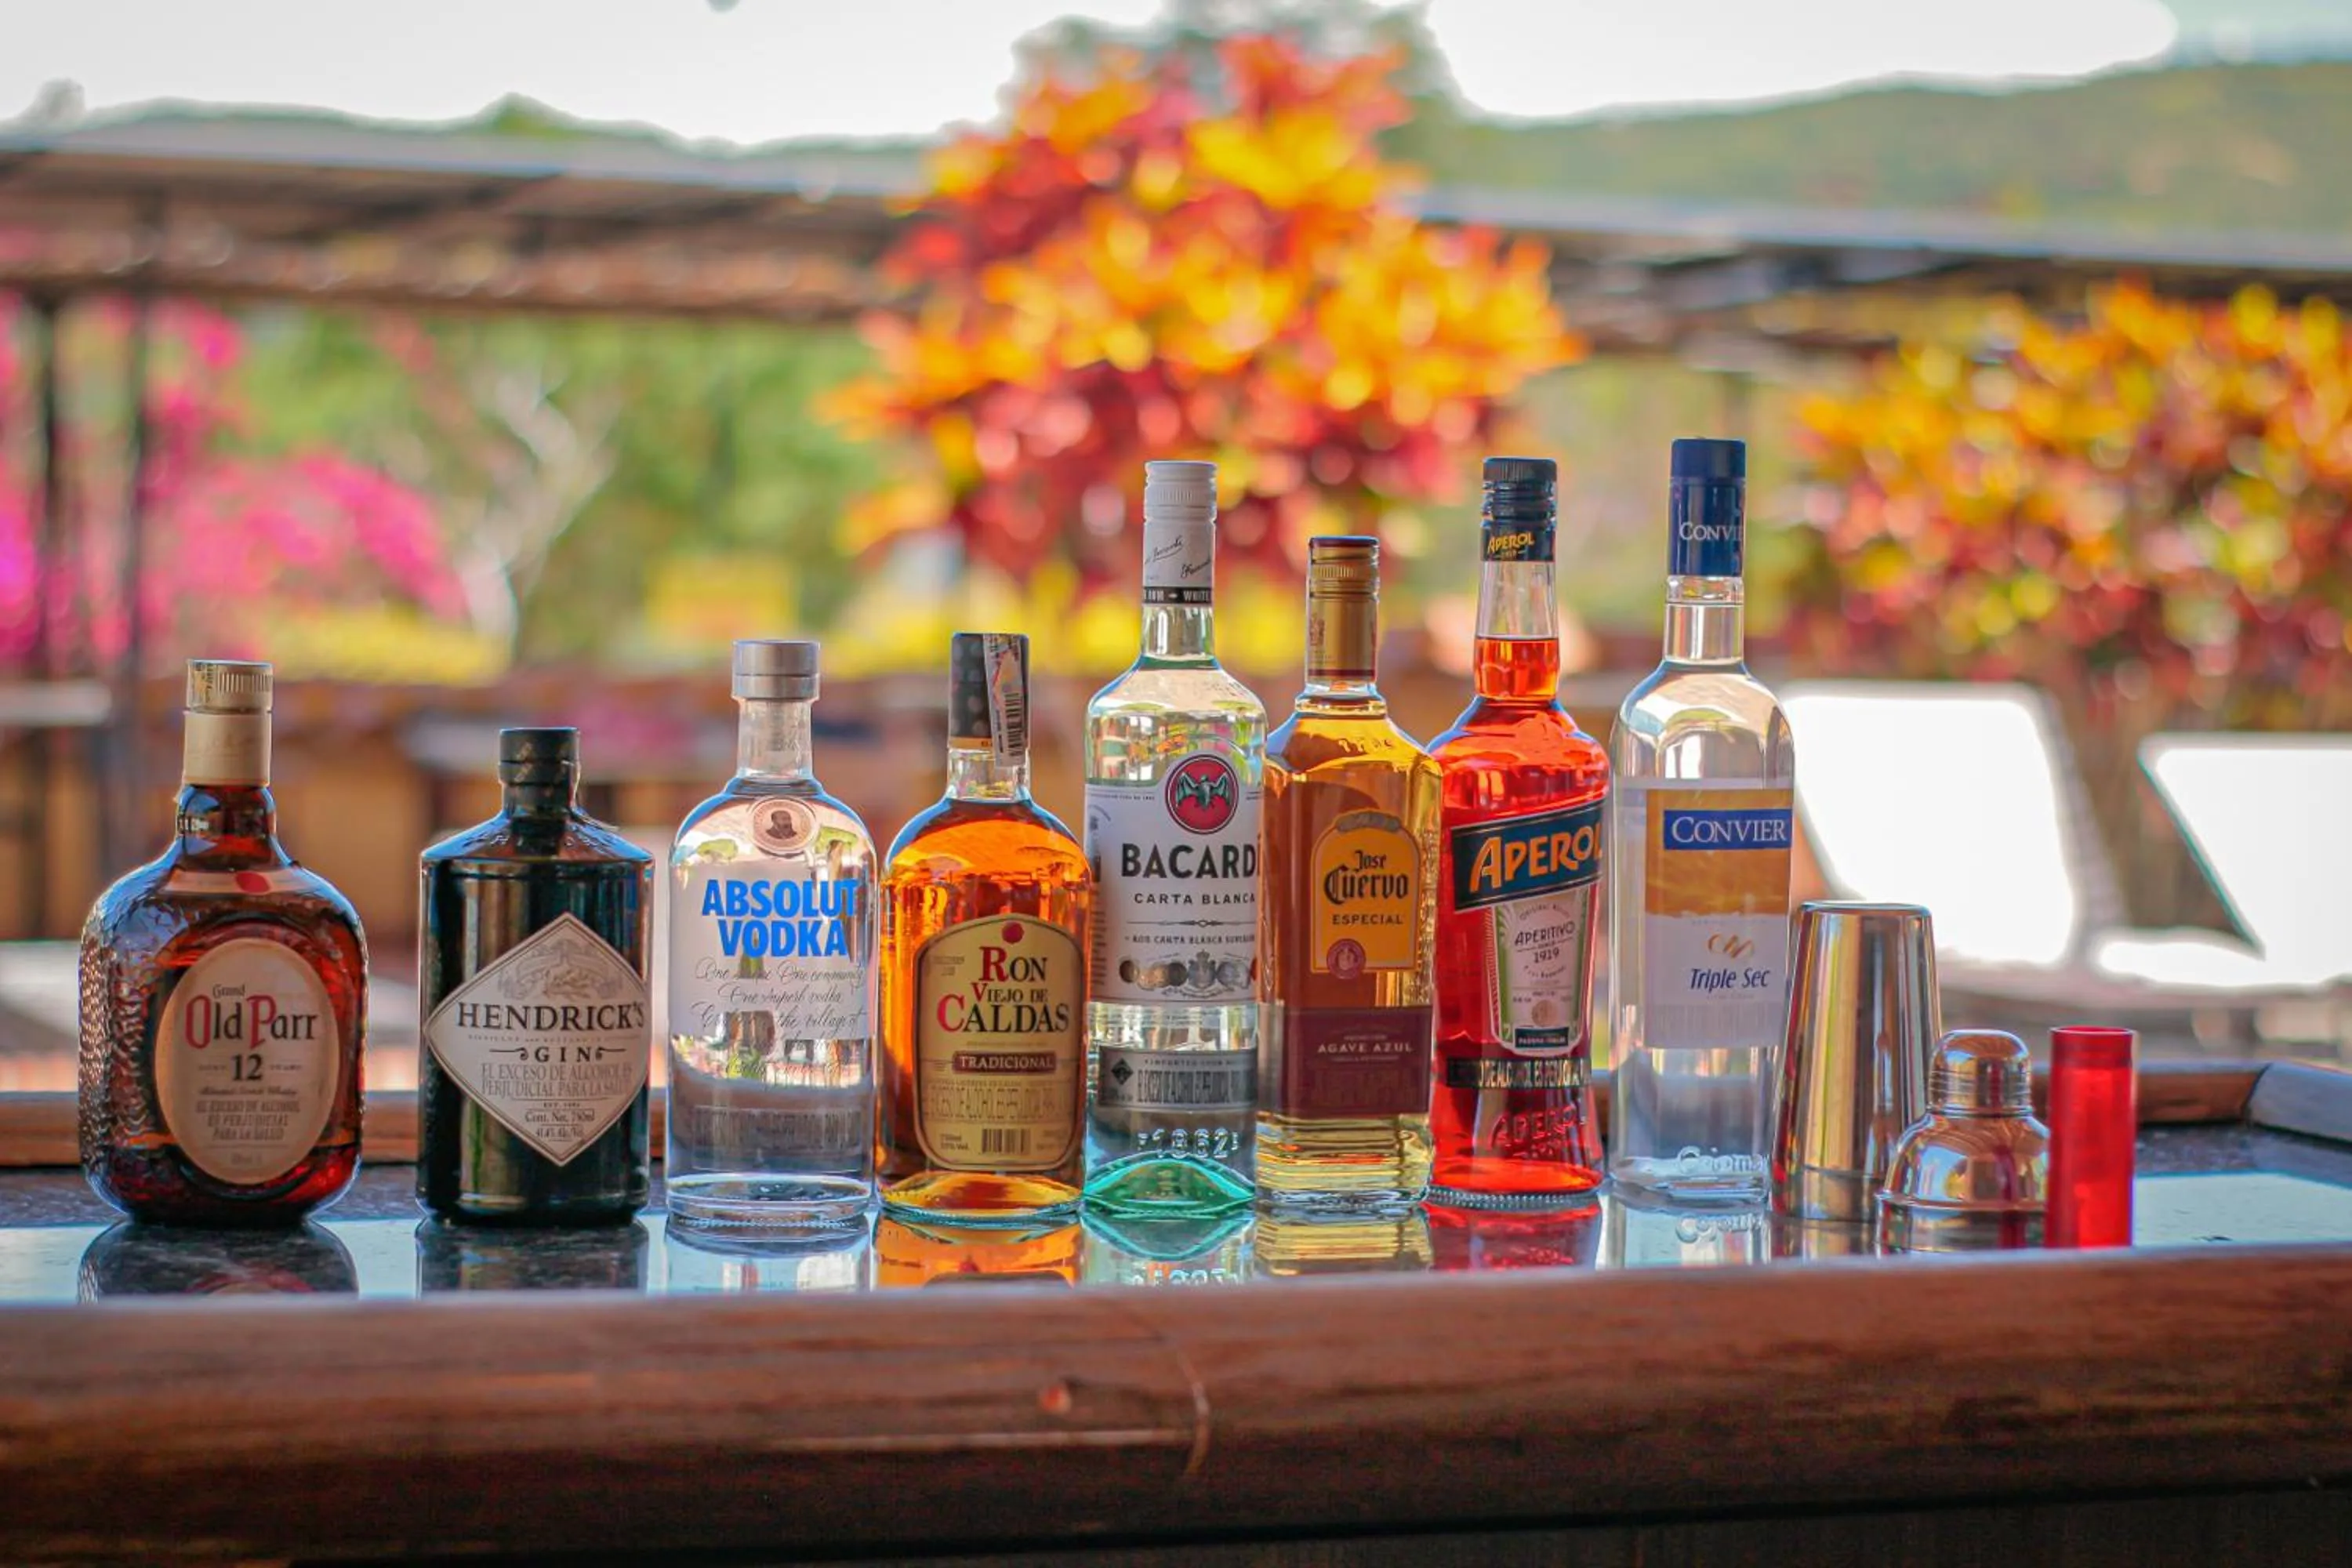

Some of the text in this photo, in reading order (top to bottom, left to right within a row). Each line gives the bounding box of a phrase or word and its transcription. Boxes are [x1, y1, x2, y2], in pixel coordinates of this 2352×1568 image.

[1487, 531, 1535, 554] APEROL
[1671, 816, 1787, 843] CONVIER
[1469, 823, 1602, 893] APEROL
[1324, 863, 1409, 905] Cuervo
[702, 879, 858, 918] ABSOLUT
[1134, 893, 1192, 904] CARTA
[1333, 914, 1403, 925] ESPECIAL
[718, 919, 848, 958] VODKA
[1515, 920, 1575, 946] APERITIVO
[978, 946, 1048, 982] RON
[1534, 947, 1559, 964] 1919
[971, 982, 1048, 1003] VIEJO DE
[1690, 967, 1770, 993] Triple Sec
[185, 995, 318, 1049] Old Parr
[457, 1000, 644, 1032] HENDRICK'S
[937, 994, 1069, 1033] CALDAS
[535, 1046, 591, 1062] GIN
[1317, 1042, 1412, 1053] AGAVE AZUL
[230, 1054, 263, 1081] 12
[960, 1055, 1054, 1069] TRADICIONAL
